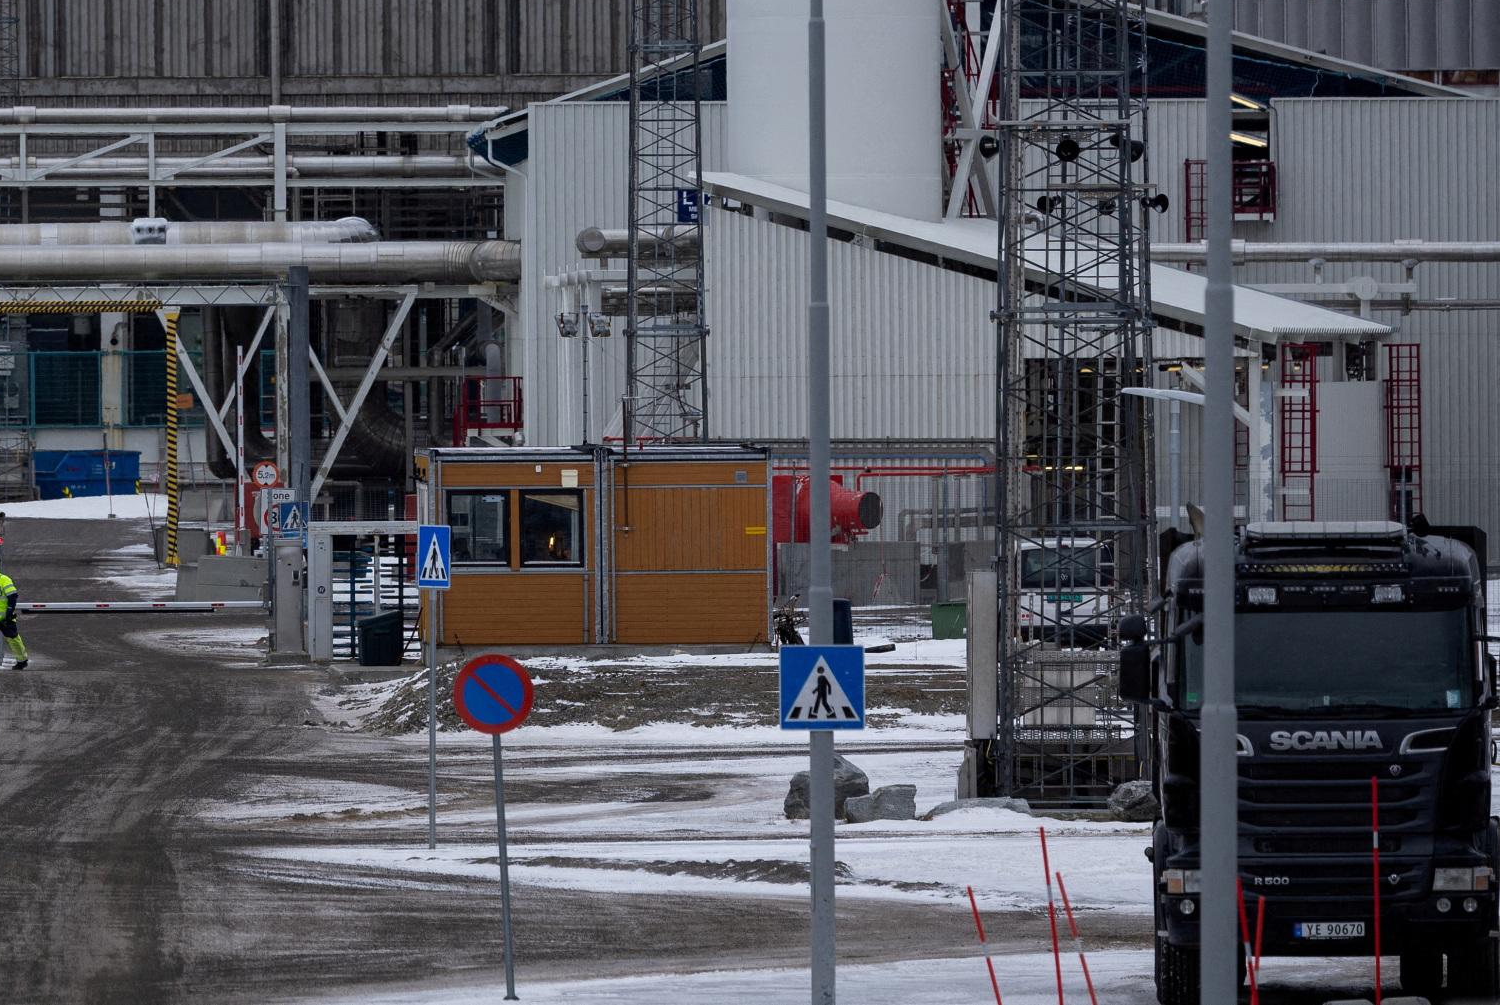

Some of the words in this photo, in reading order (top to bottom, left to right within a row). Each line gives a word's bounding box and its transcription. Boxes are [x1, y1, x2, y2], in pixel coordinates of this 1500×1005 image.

[1269, 730, 1384, 750] SCANIA
[1254, 877, 1263, 885] R
[1264, 877, 1290, 885] 500
[1306, 923, 1325, 935] YE
[1327, 923, 1364, 936] 90670
